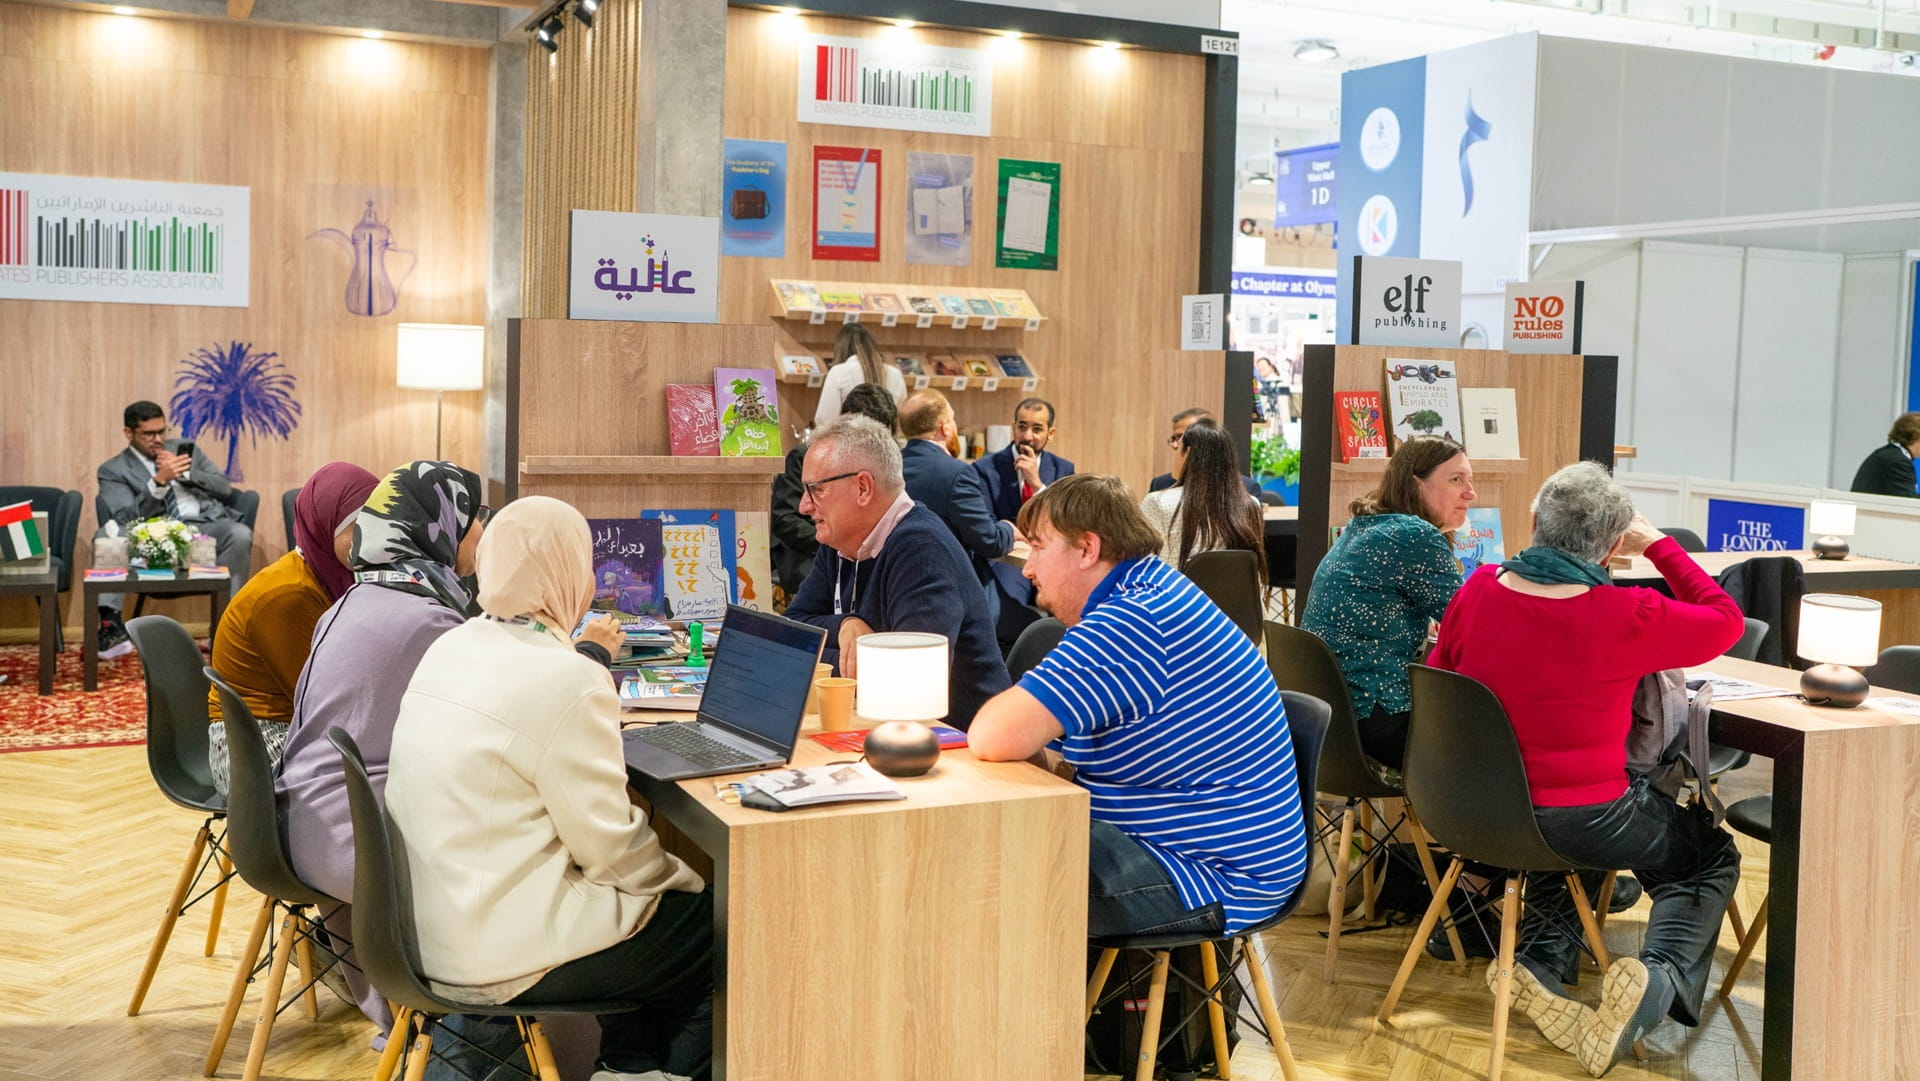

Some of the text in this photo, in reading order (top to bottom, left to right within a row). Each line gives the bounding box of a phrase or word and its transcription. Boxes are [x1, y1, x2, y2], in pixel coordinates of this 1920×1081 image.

[1205, 39, 1237, 52] 1E121
[1311, 187, 1330, 206] 1D
[111, 197, 172, 215] الناشرين
[178, 203, 224, 217] جمعية
[36, 268, 128, 287] PUBLISHERS
[132, 272, 224, 291] ASSOCIATION
[594, 249, 696, 301] عالية
[1240, 277, 1289, 295] Chapter
[1290, 281, 1303, 294] at
[1304, 281, 1336, 298] Olym
[1383, 273, 1433, 314] elf
[1513, 316, 1563, 331] rules
[1512, 332, 1563, 340] PUBLISHING
[1342, 396, 1379, 409] CIRCLE
[1347, 435, 1384, 448] SPICES
[1737, 520, 1772, 538] THE
[1722, 533, 1788, 551] LONDON
